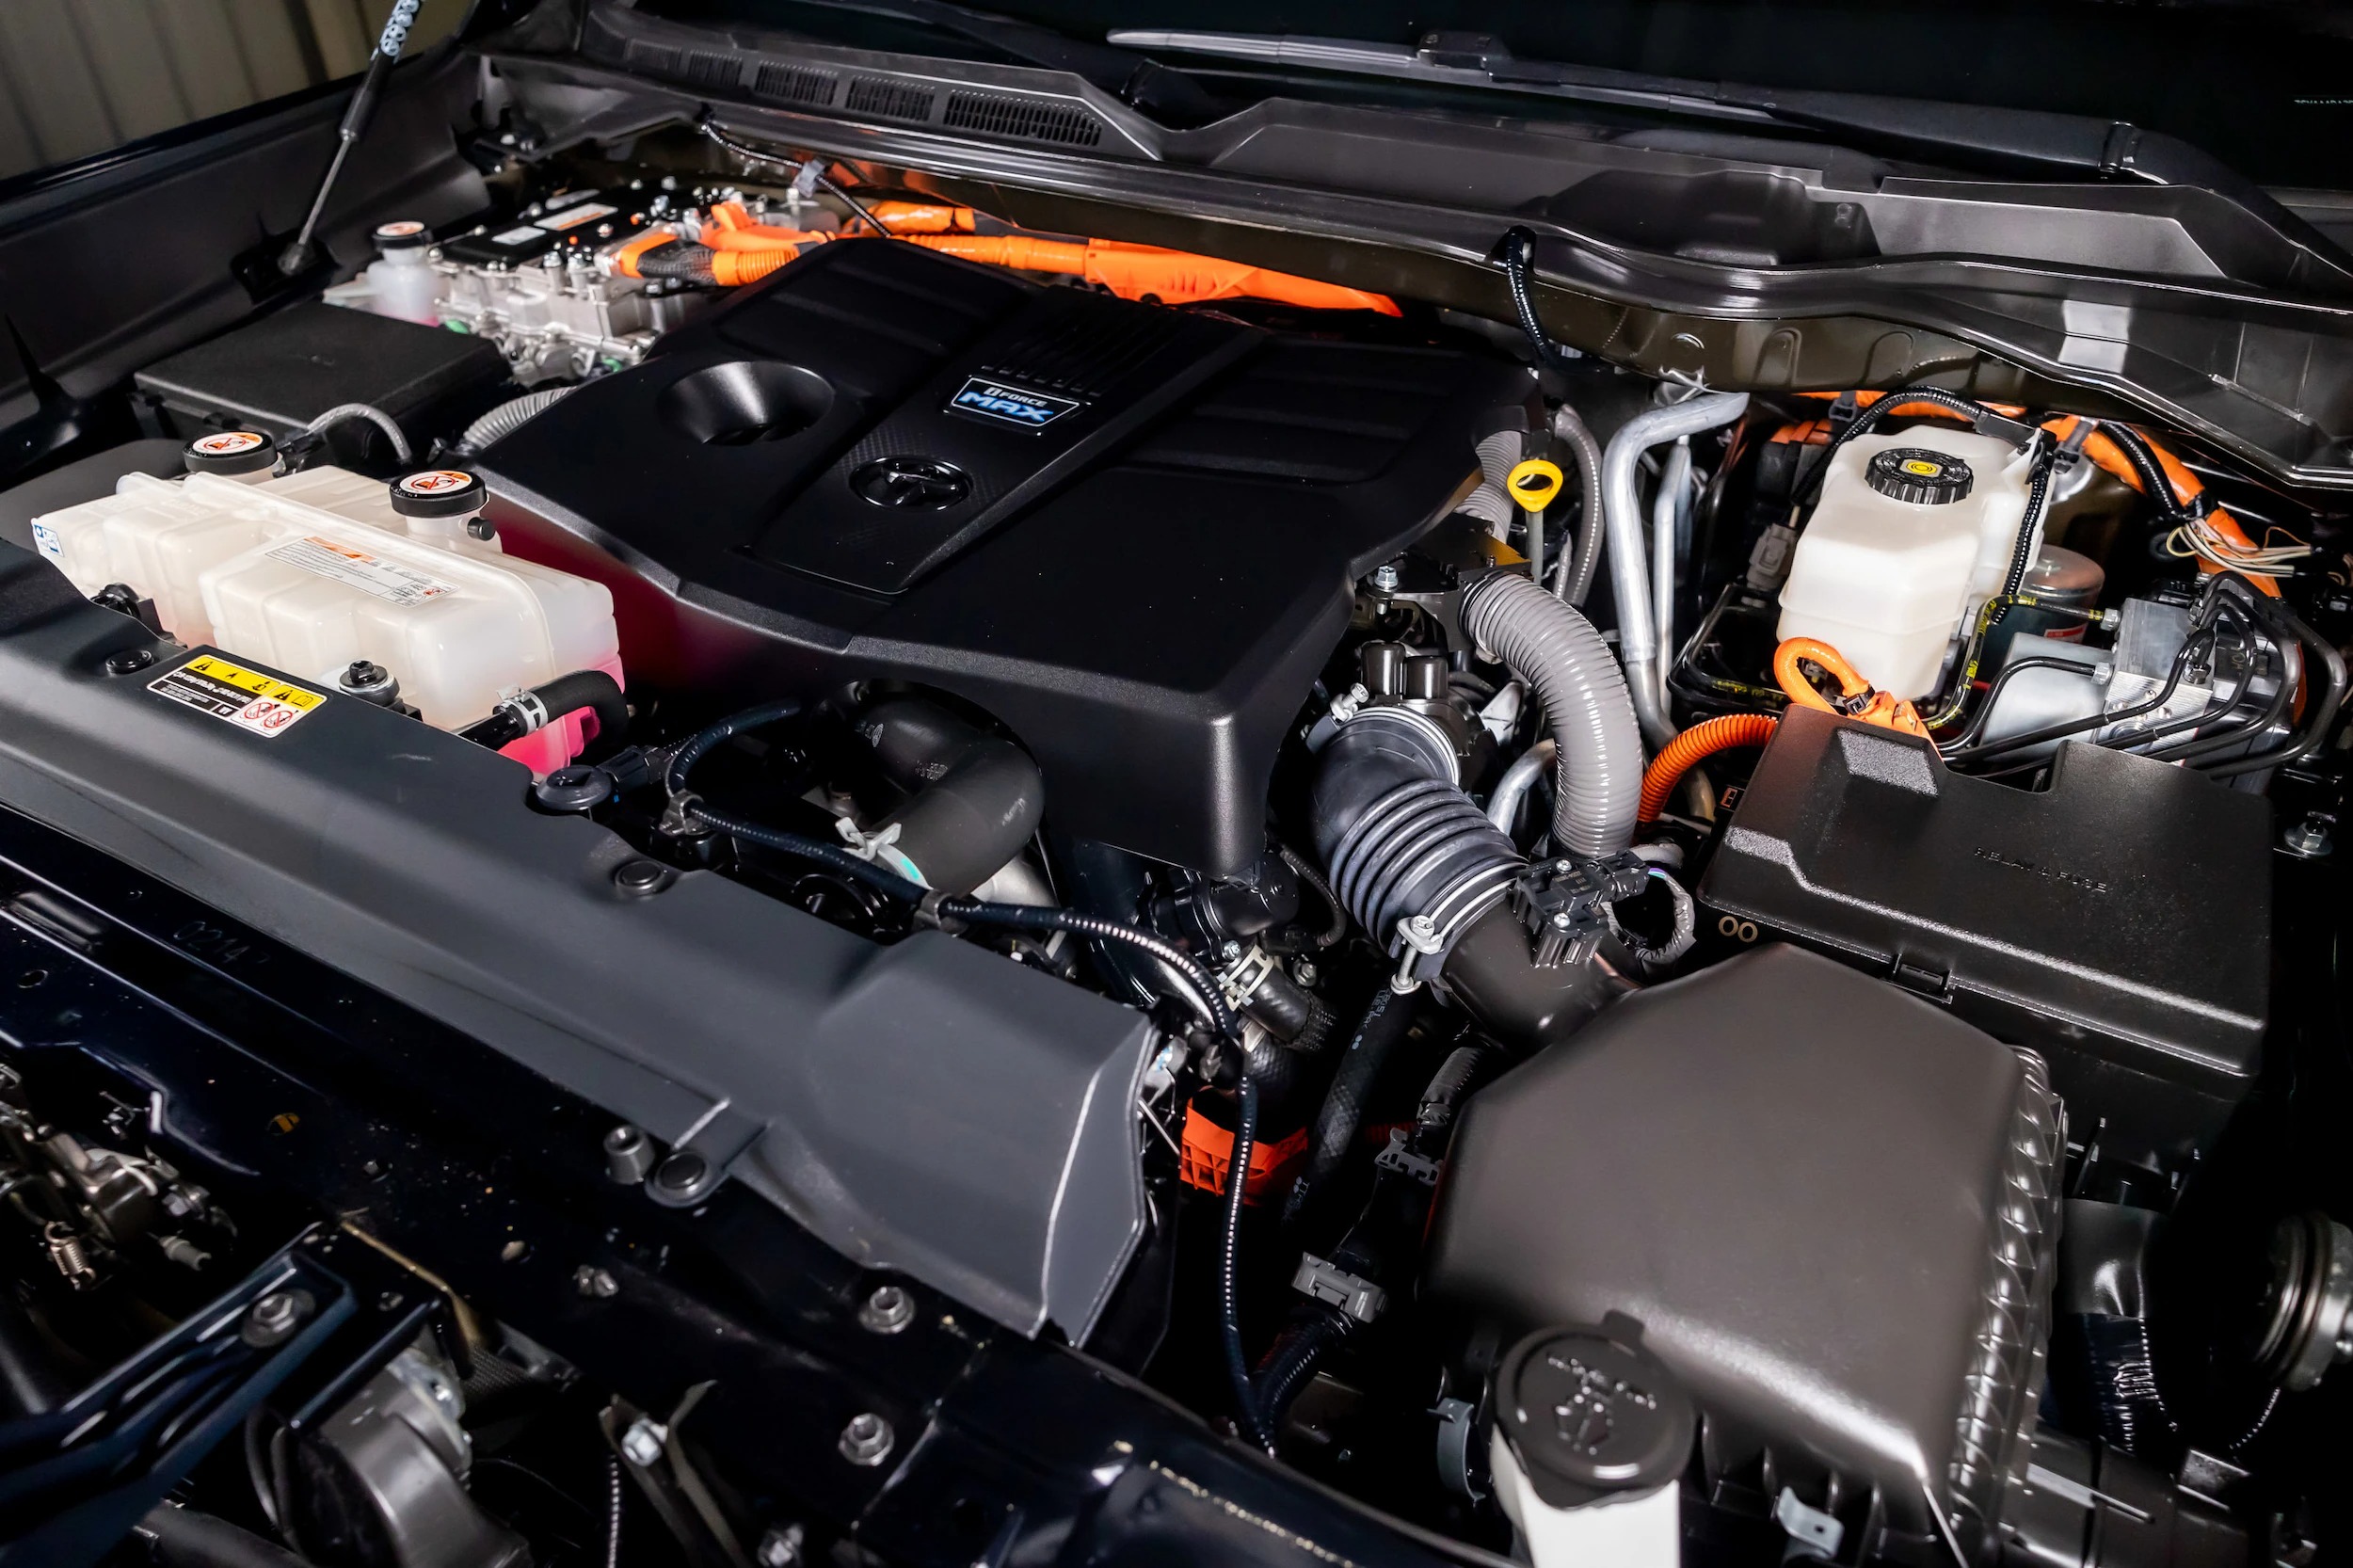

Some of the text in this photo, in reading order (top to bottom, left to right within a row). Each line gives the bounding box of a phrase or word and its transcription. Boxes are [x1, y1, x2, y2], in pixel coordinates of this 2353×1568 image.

[957, 392, 1053, 422] MAX
[1975, 847, 2035, 872] RELAY
[2057, 871, 2107, 893] FUSE
